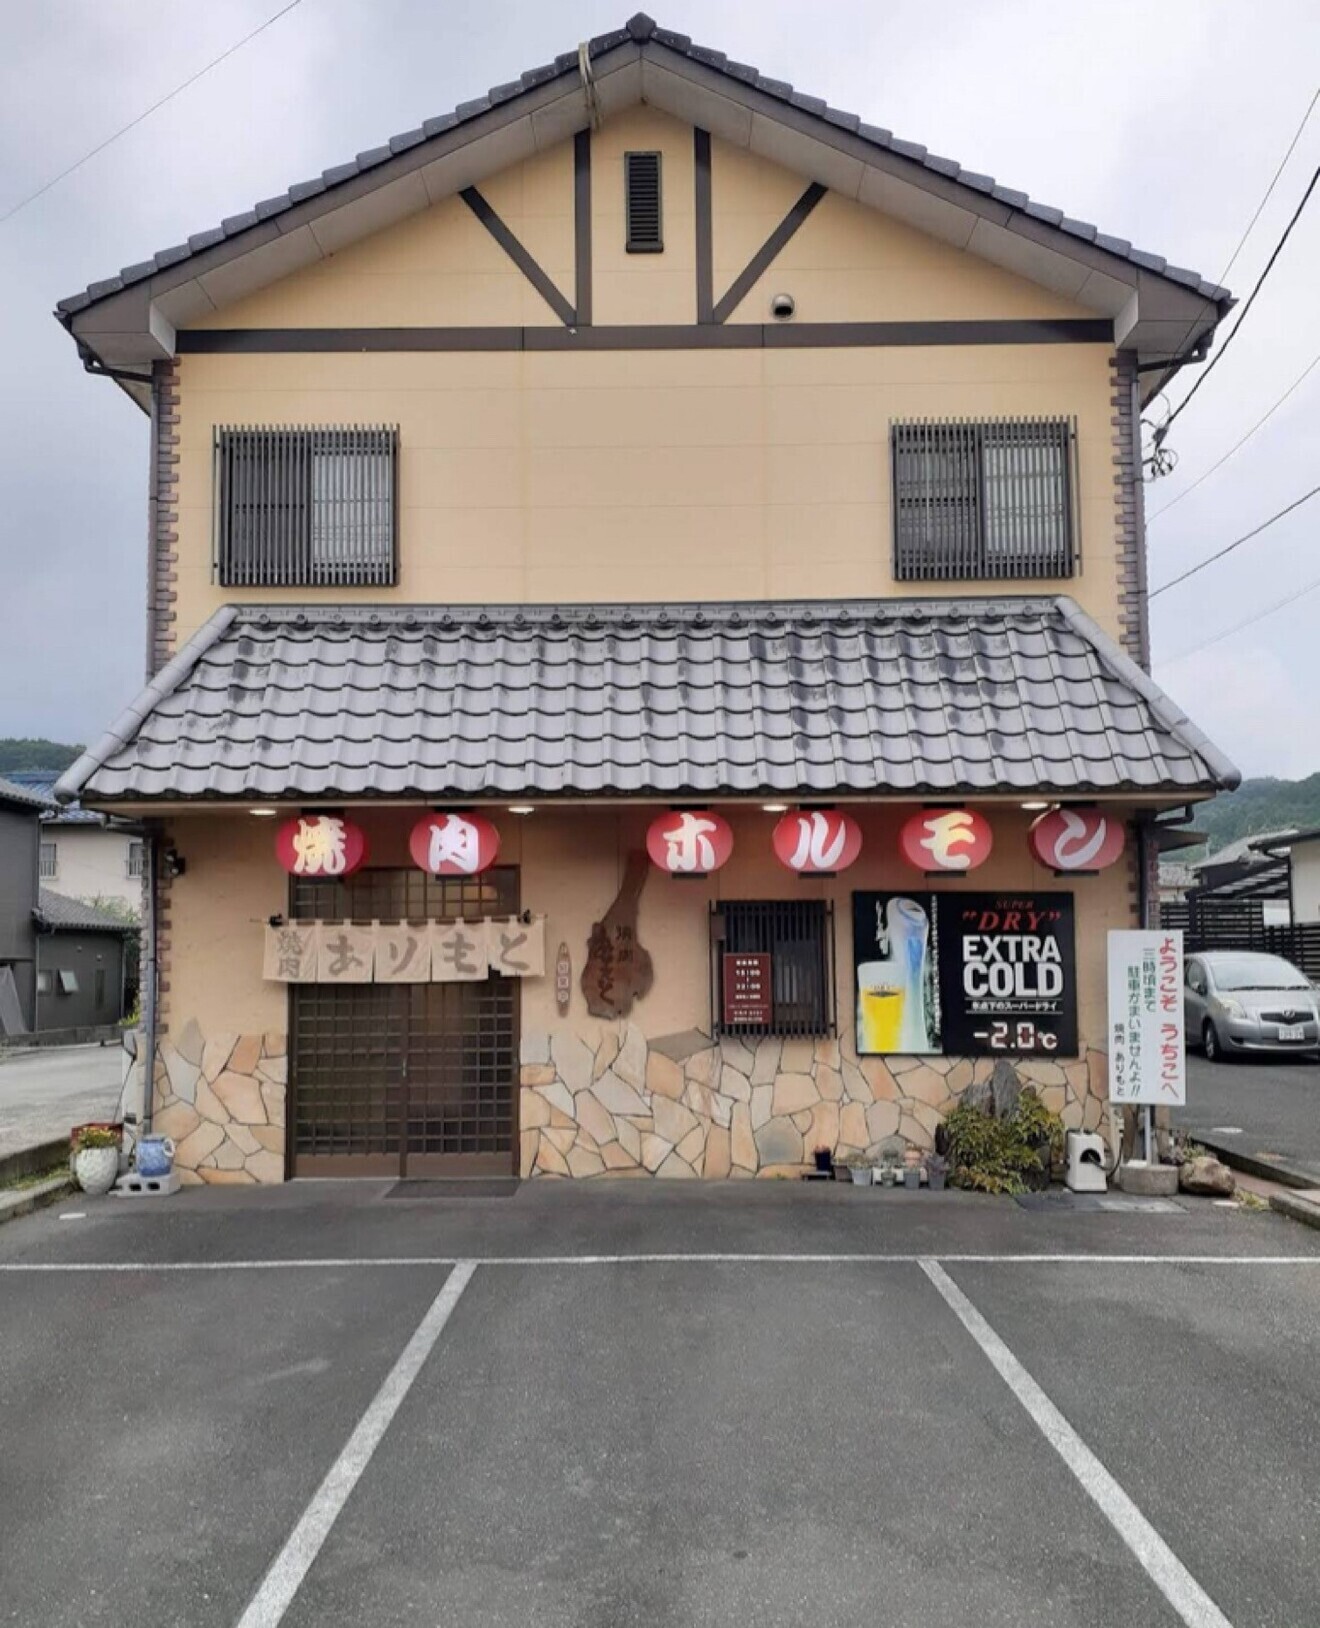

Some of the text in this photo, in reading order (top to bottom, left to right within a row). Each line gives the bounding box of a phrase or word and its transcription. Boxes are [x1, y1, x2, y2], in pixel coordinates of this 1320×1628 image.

[278, 931, 302, 977] 焼肉
[962, 935, 1062, 962] EXTRA
[963, 961, 1064, 997] COLD
[1159, 937, 1179, 1098] ようこそ うちこへ
